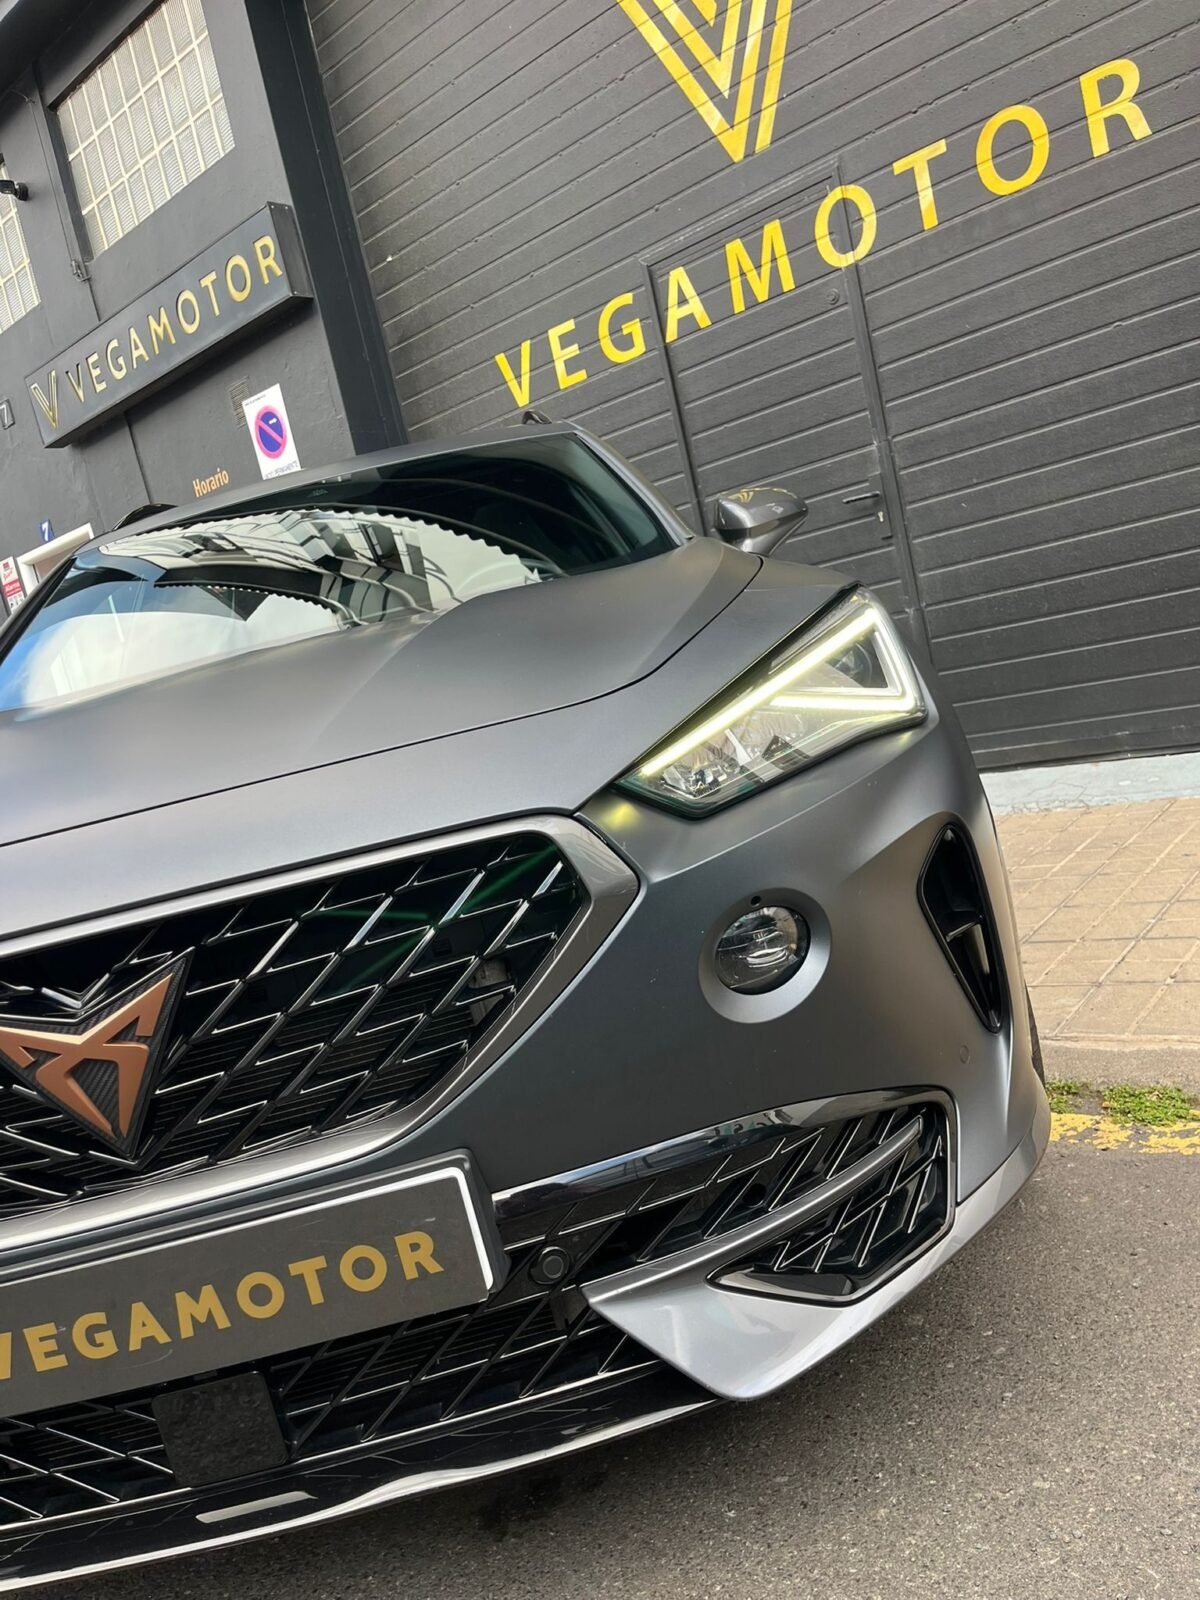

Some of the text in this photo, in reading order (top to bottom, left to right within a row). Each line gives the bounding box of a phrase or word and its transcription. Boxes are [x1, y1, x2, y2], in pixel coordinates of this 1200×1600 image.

[495, 57, 1152, 408] VEGAMOTOR
[65, 235, 283, 403] VEGAMOTOR
[41, 520, 49, 542] 7
[192, 467, 229, 498] Horario
[0, 1230, 444, 1381] EGAMOTOR
